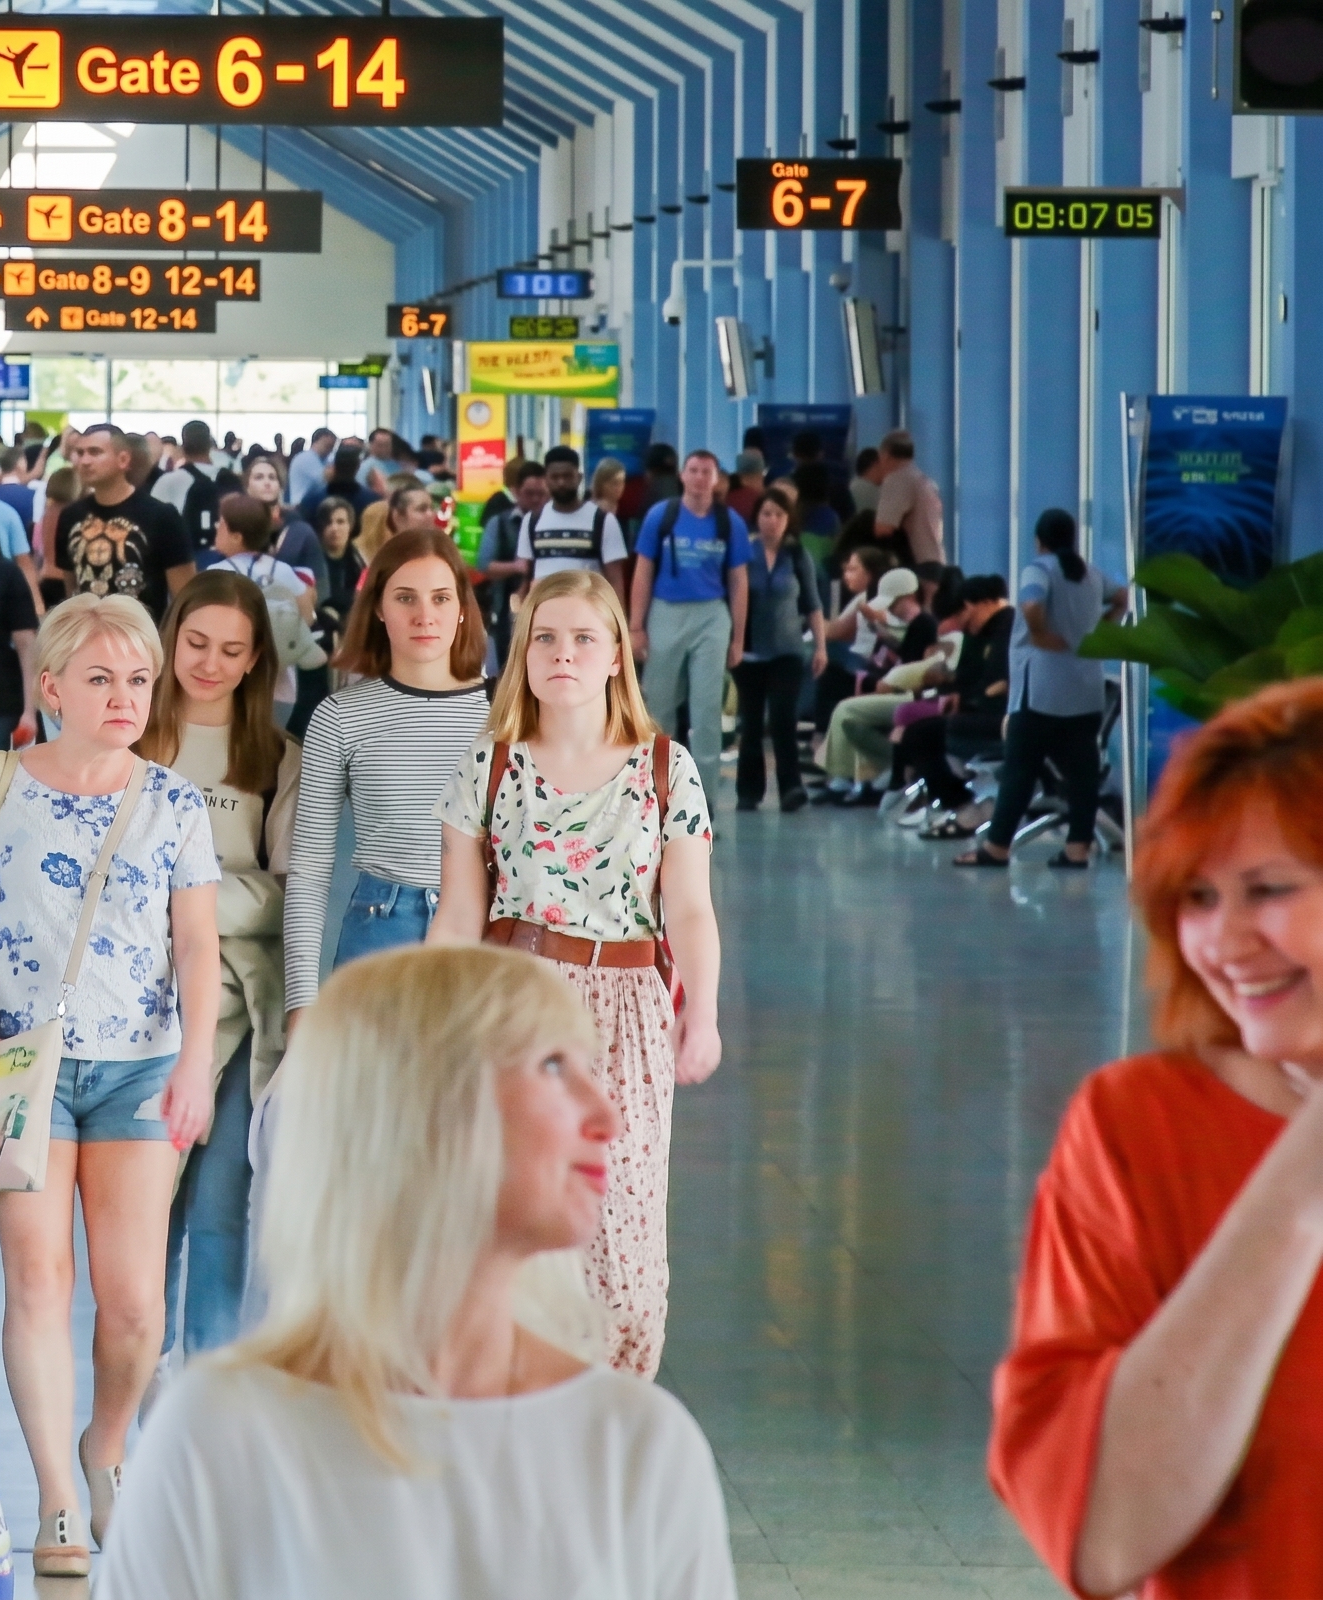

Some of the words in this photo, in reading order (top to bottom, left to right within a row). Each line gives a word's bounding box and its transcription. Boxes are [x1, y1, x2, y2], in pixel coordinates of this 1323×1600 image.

[76, 46, 201, 96] Gate
[772, 178, 867, 227] 6-7
[1014, 202, 1109, 229] 09:07
[1117, 204, 1153, 228] 05
[78, 205, 152, 235] Gate
[92, 265, 151, 296] 8-9
[164, 265, 256, 296] 12-14
[130, 307, 197, 330] 12-14
[401, 313, 447, 337] 6-7
